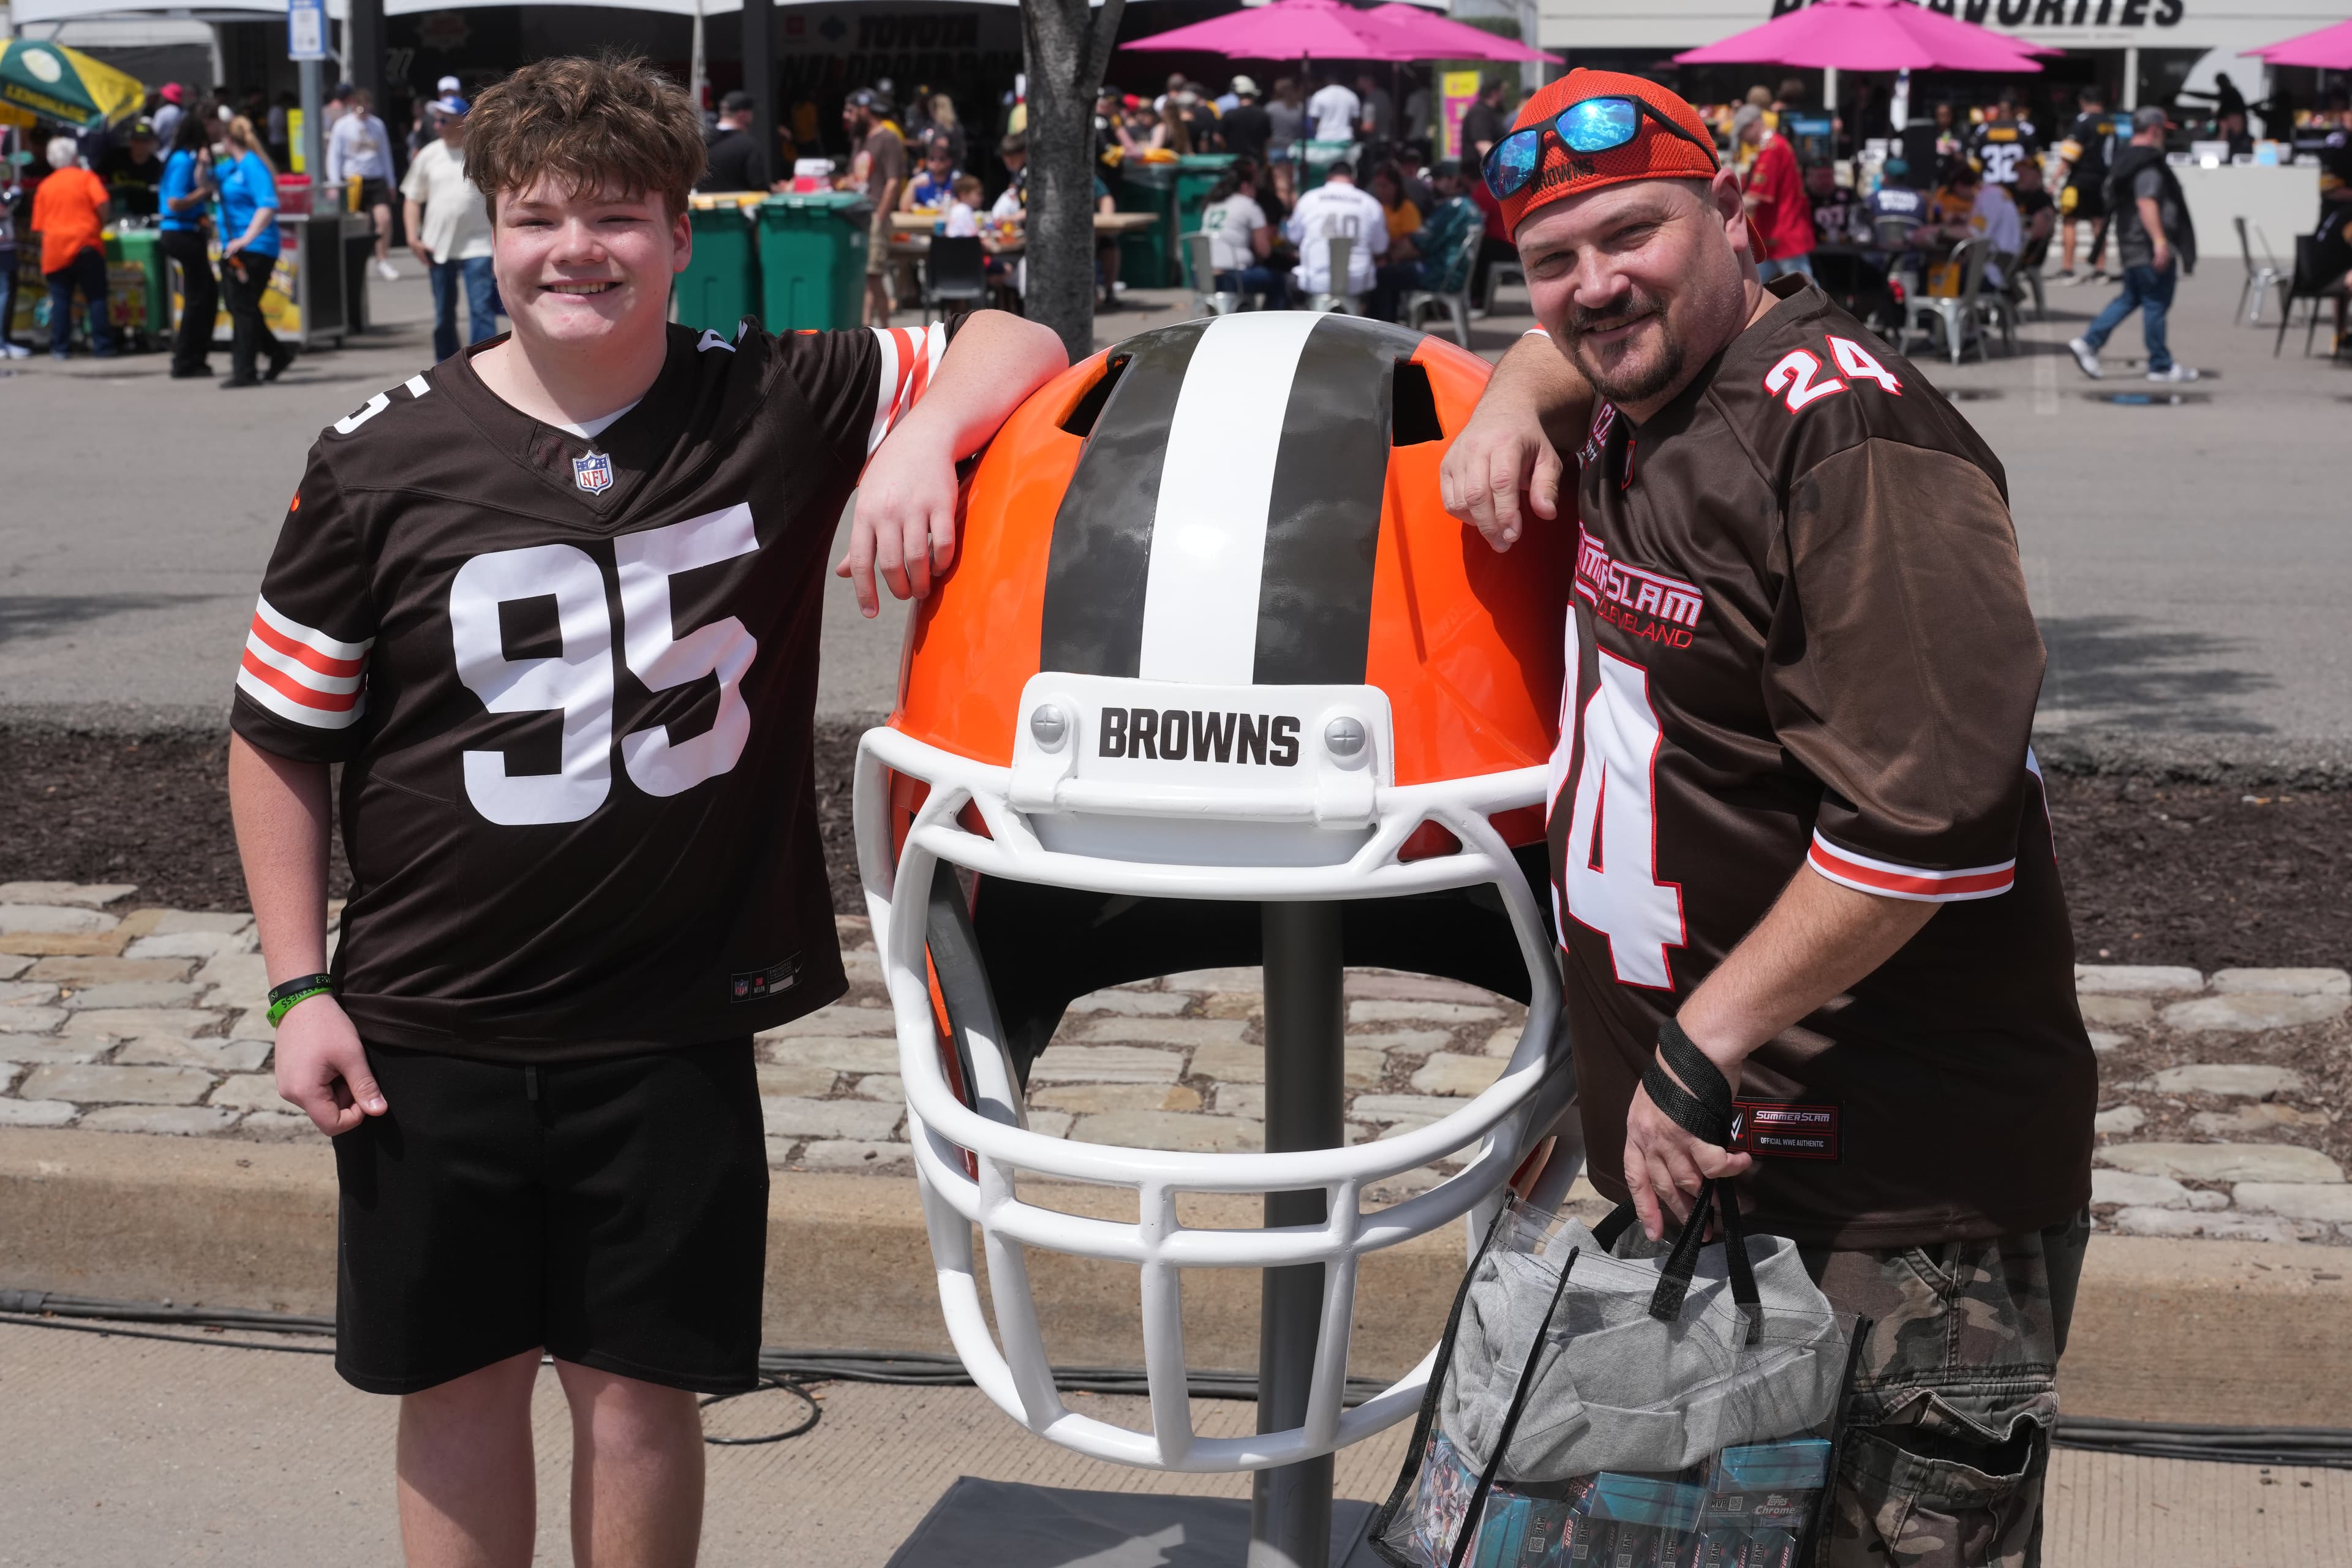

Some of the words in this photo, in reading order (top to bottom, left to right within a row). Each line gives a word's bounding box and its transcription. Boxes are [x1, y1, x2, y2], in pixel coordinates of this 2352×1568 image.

[1899, 0, 2184, 26] AVORITES
[1981, 143, 2024, 183] 32
[1763, 335, 1902, 414] 24
[581, 470, 608, 488] NFL
[1597, 598, 1693, 649] CLEVELAND
[450, 501, 760, 826] 95
[1099, 707, 1300, 767] BROWNS
[1755, 1110, 1830, 1122] SUMMERSLAM
[1754, 1505, 1795, 1515] Chrome
[1537, 1516, 1546, 1535] MVP
[1623, 1533, 1632, 1552] MVP
[1667, 1540, 1676, 1559] MVP
[1755, 1544, 1764, 1562] MVP
